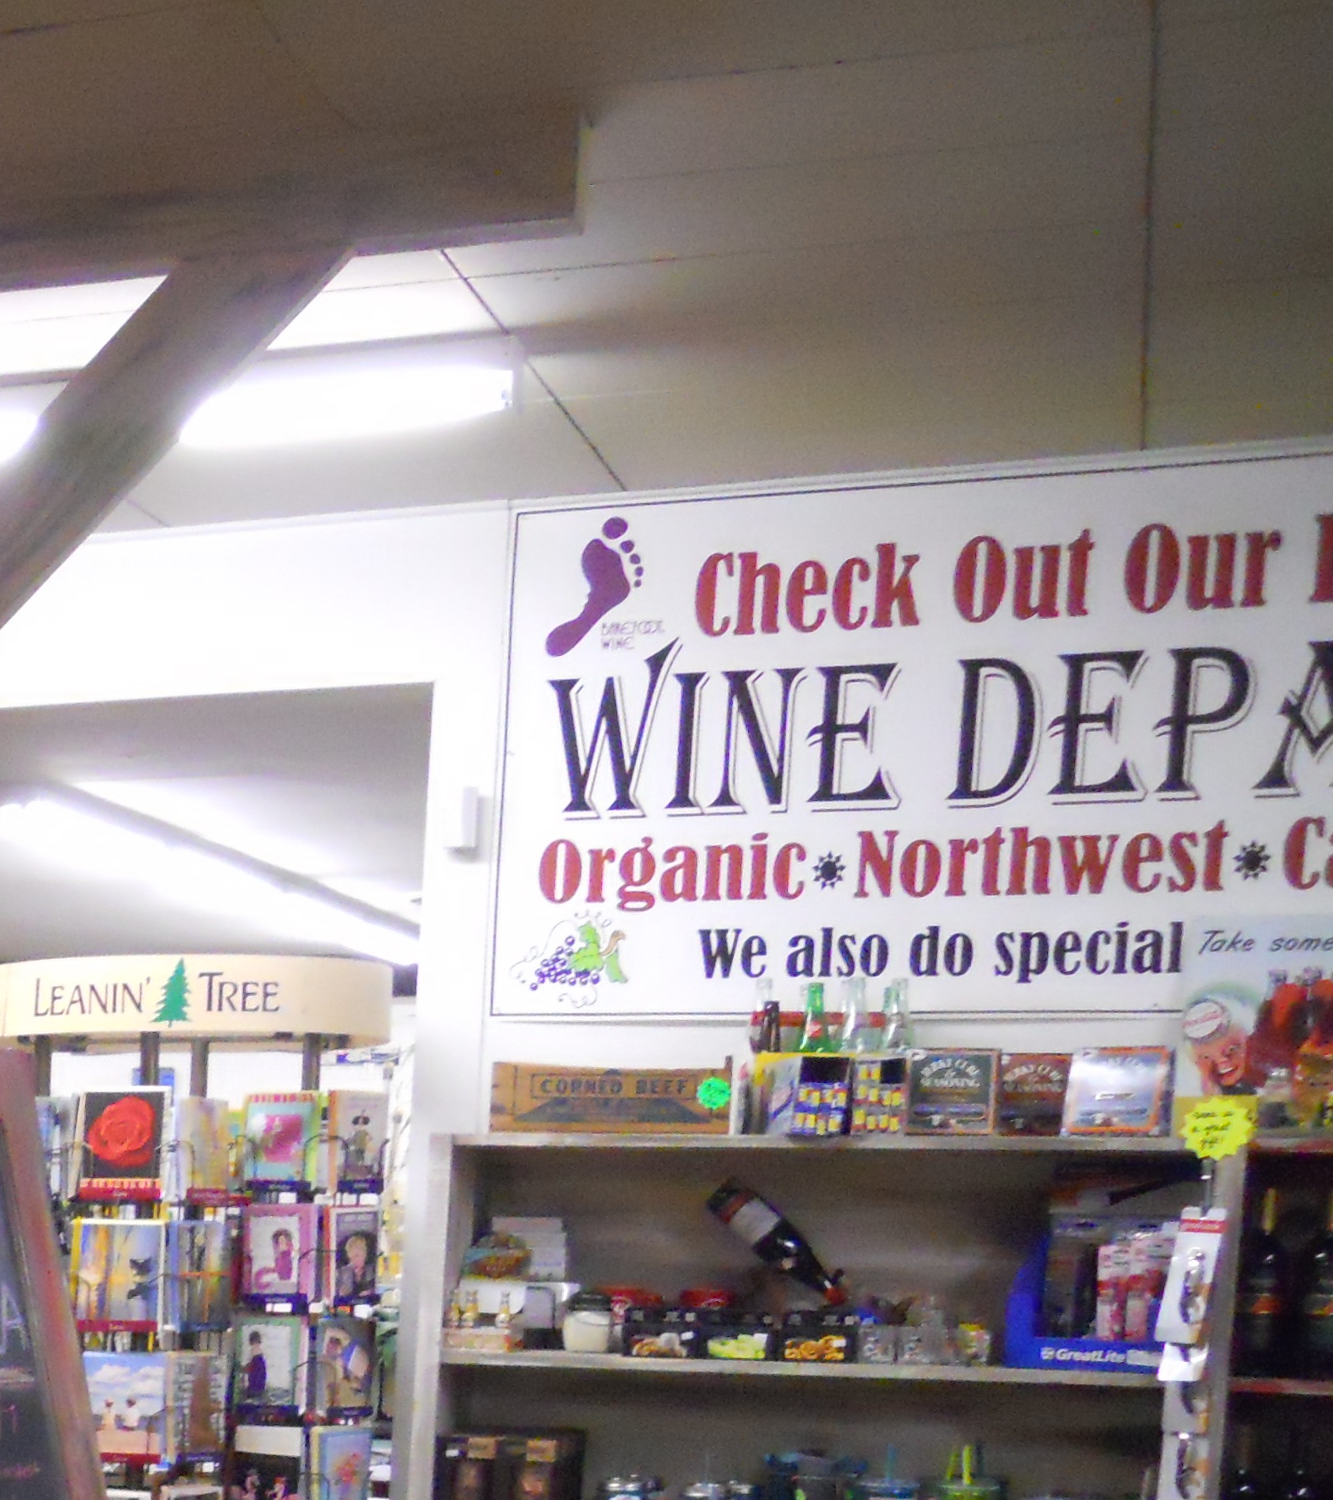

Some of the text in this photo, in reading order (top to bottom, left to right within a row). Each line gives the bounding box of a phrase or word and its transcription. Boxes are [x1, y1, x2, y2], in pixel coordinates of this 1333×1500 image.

[695, 542, 921, 637] Check
[953, 528, 1094, 623] Out
[1124, 523, 1283, 614] Our
[548, 636, 901, 820] WINE
[539, 832, 807, 912] Organic
[854, 820, 1230, 900] Northwest
[698, 921, 1184, 984] We also do special
[1198, 929, 1256, 955] Take
[198, 972, 281, 1013] TREE
[539, 1077, 687, 1095] CORNED BEEF
[1055, 1348, 1126, 1363] GreatLite
